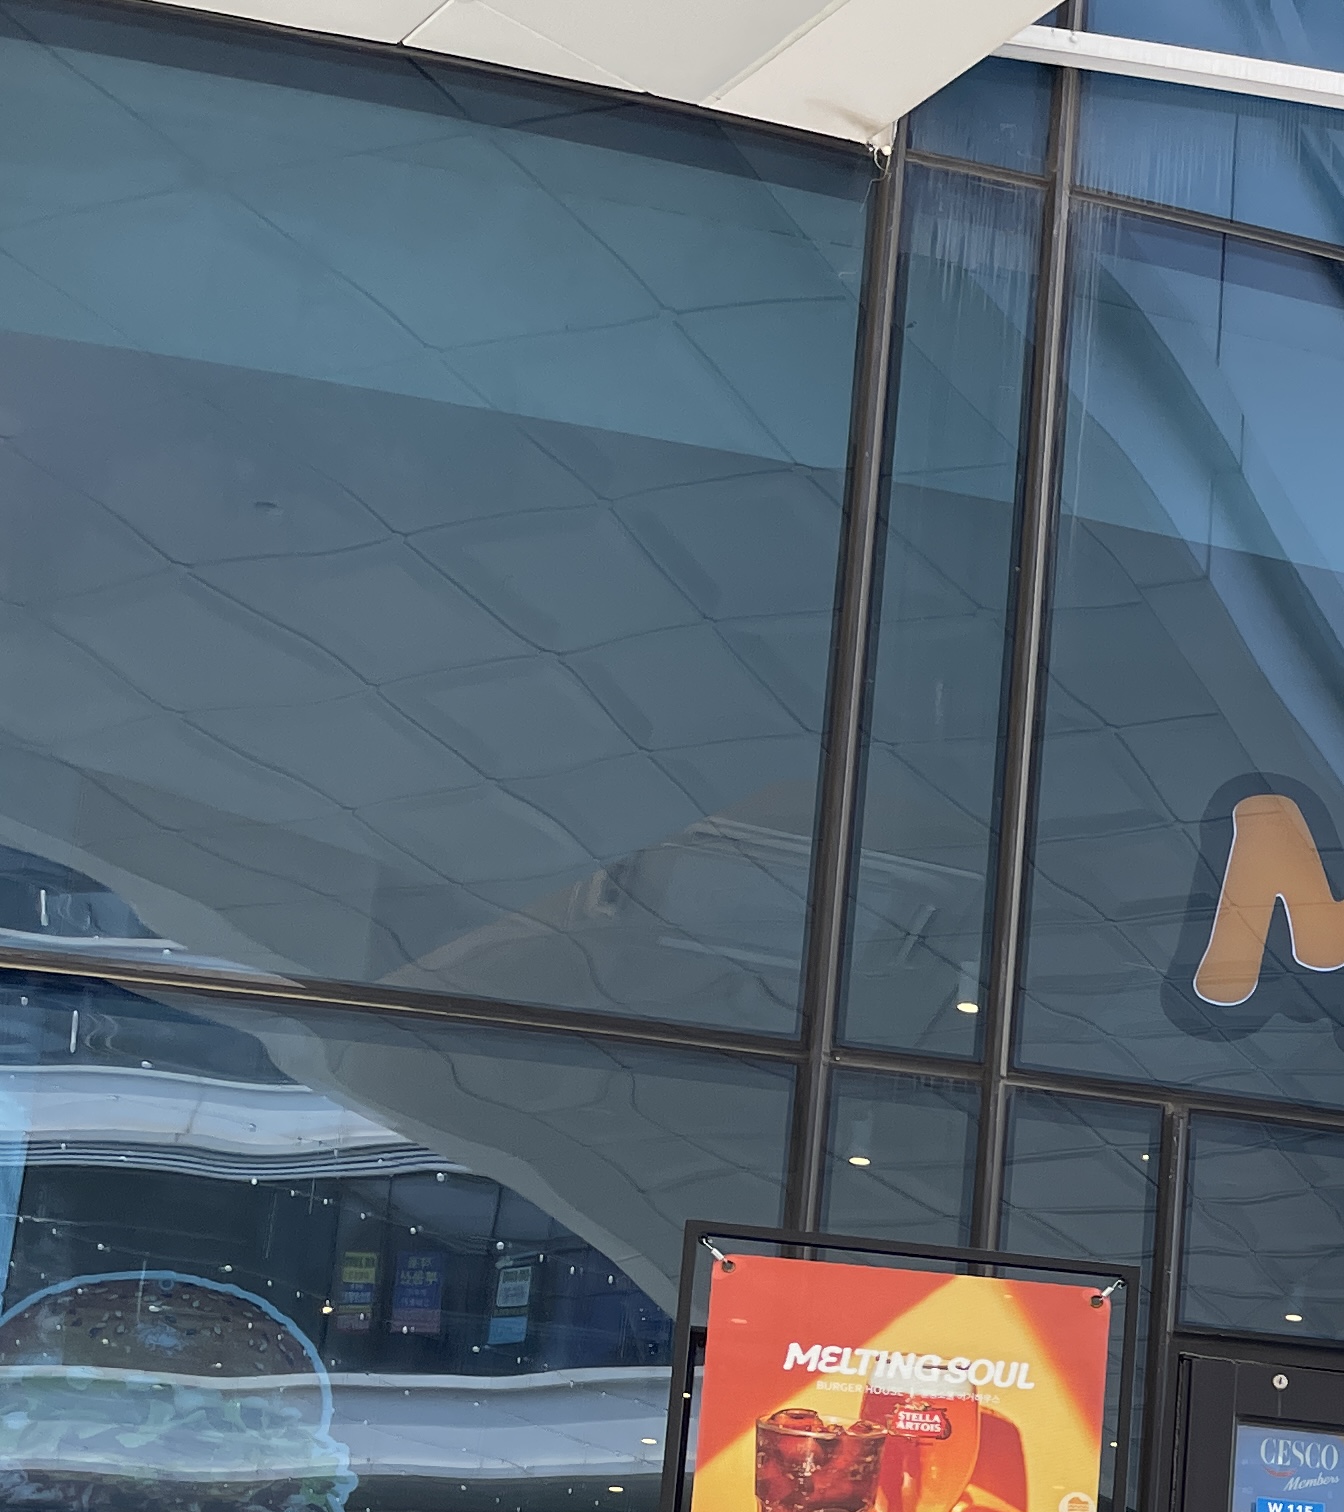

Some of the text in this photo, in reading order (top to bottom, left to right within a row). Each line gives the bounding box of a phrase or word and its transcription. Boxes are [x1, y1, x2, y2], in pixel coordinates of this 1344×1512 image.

[898, 1411, 941, 1423] STELLA
[896, 1421, 942, 1433] ARTOIS
[1260, 1437, 1339, 1471] CESCO
[1283, 1472, 1340, 1492] Members
